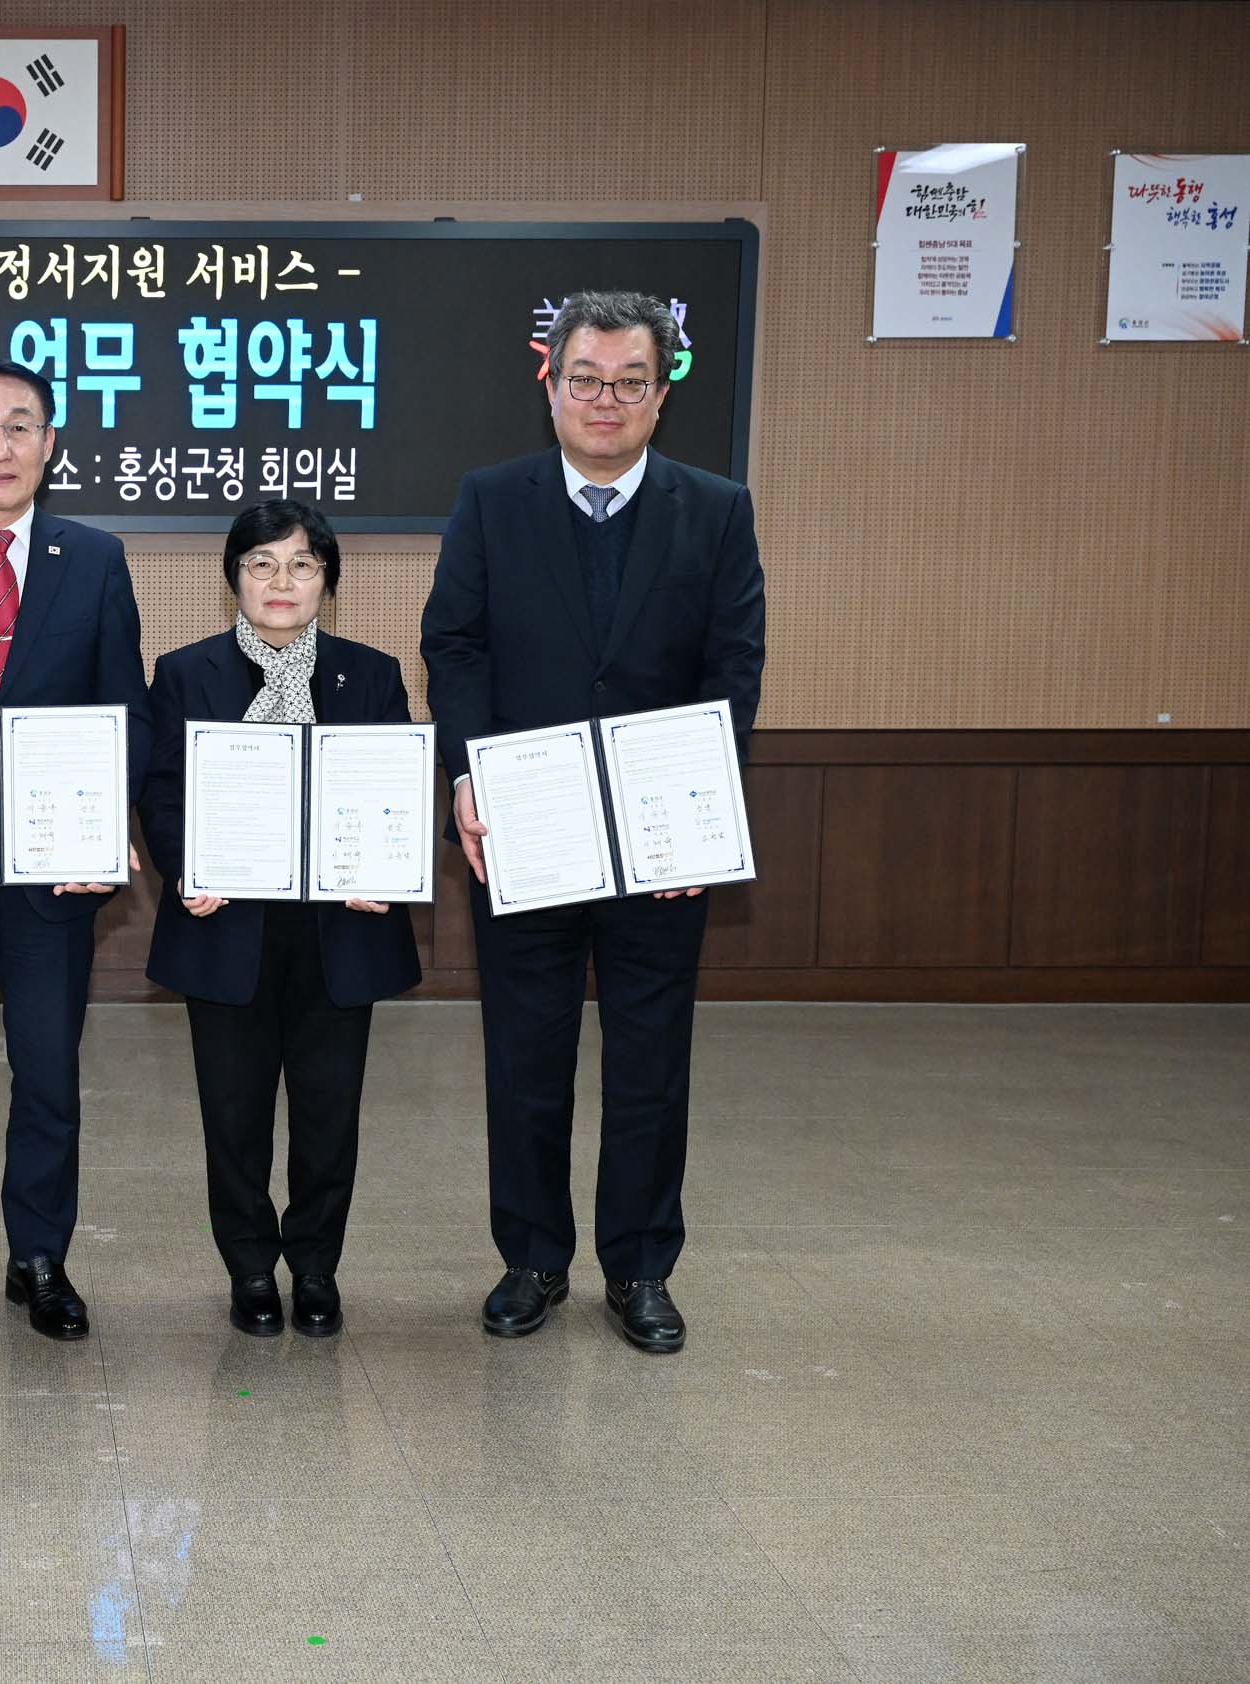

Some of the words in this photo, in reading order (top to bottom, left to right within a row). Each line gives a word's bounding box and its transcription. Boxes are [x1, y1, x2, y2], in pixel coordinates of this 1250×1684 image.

[1128, 183, 1172, 205] 따뜻한
[1173, 178, 1204, 204] 동행
[1166, 206, 1202, 230] 행복한
[1206, 201, 1237, 231] 홍성
[186, 244, 318, 300] 서비스
[10, 317, 142, 429] 업무
[178, 316, 377, 429] 협약식
[114, 447, 244, 501] 홍성군청
[260, 447, 356, 501] 회의실
